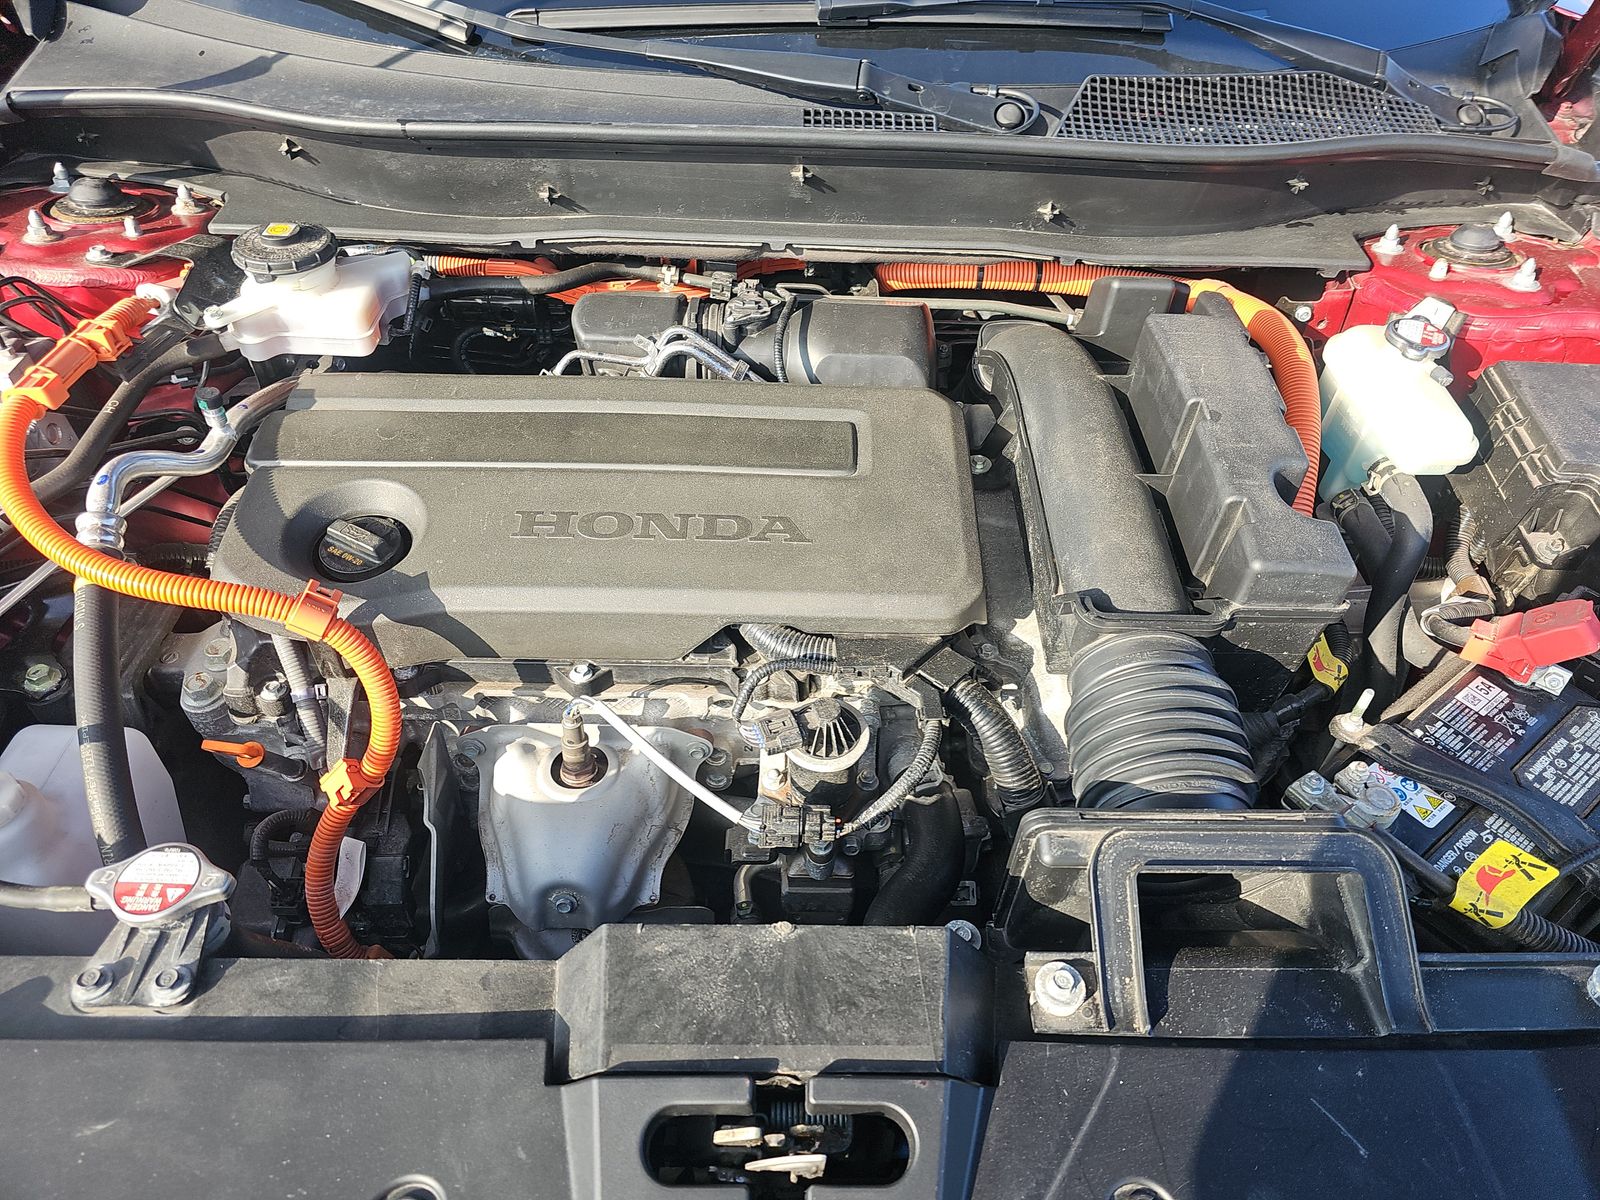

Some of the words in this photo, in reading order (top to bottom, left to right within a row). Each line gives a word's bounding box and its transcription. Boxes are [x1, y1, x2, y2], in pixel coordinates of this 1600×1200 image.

[510, 510, 814, 544] HONDA
[327, 545, 342, 556] SAE
[342, 553, 363, 566] 0W-20
[1475, 681, 1495, 696] 5A
